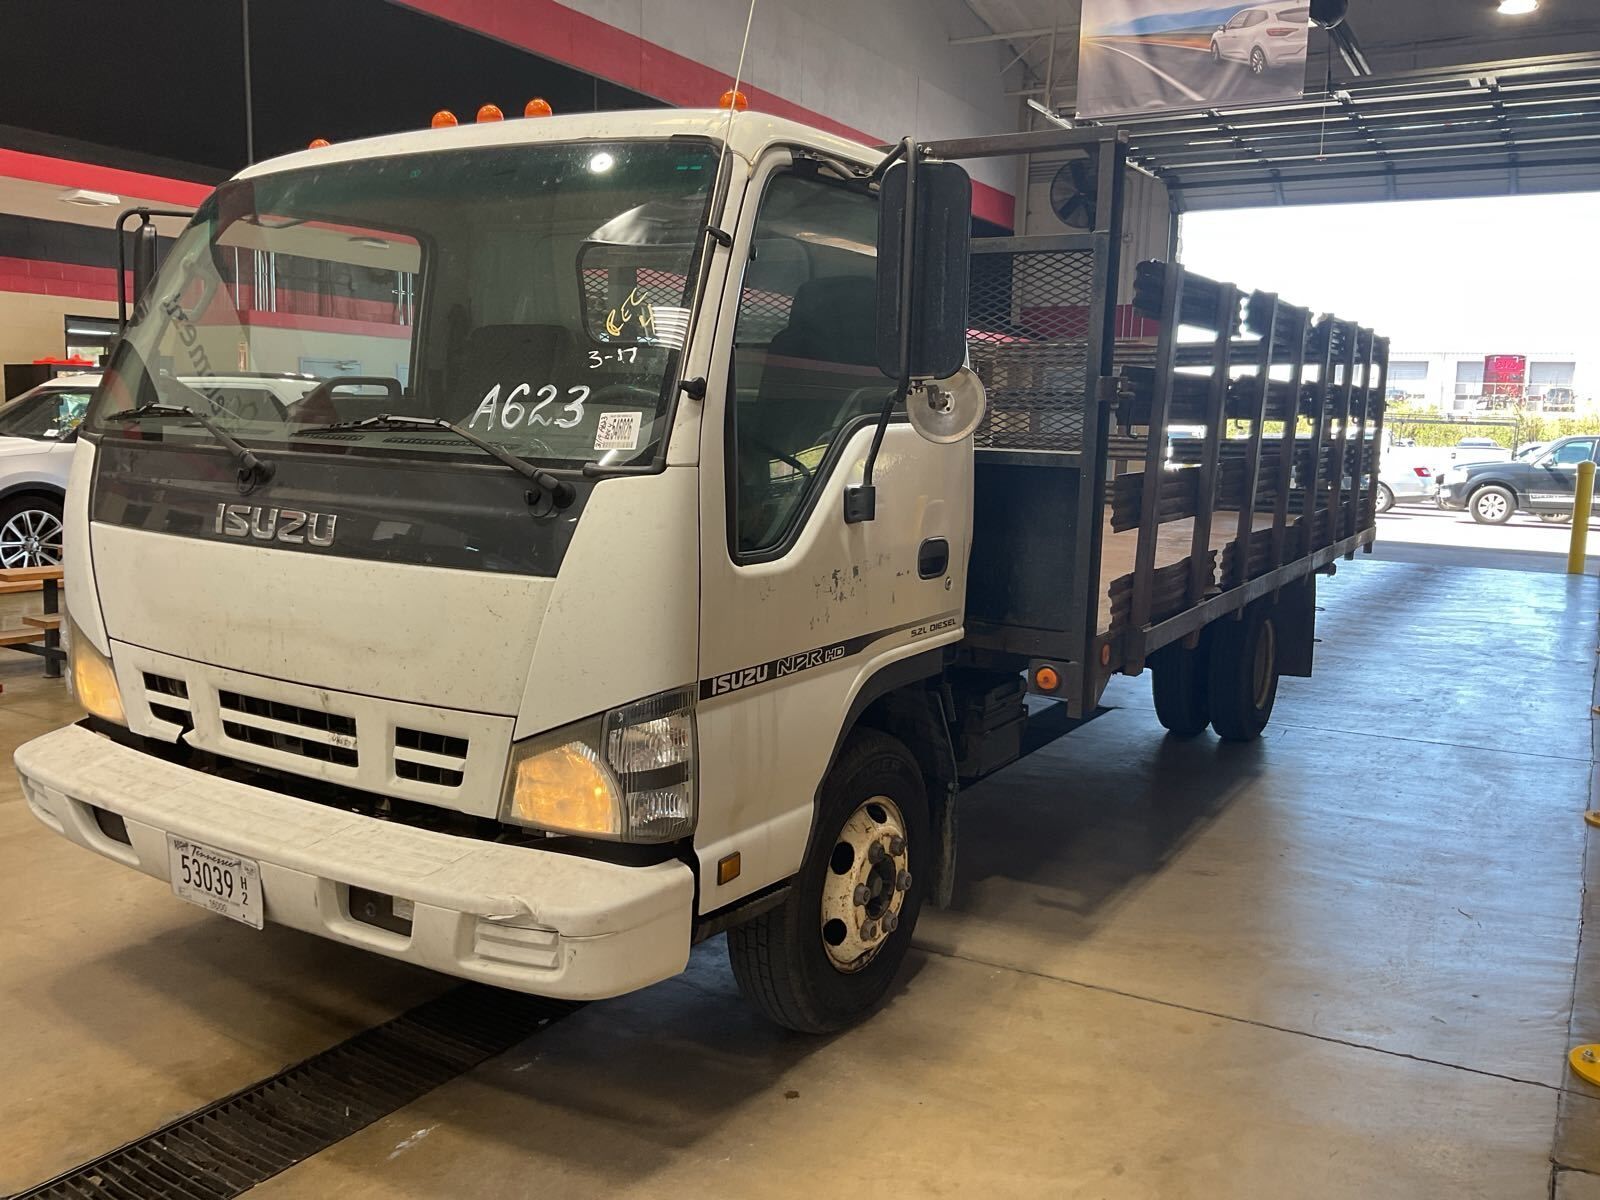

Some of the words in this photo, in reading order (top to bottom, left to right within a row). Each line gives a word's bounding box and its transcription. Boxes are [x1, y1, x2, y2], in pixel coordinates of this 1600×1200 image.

[468, 383, 590, 431] A623
[215, 502, 338, 547] ISUZU
[929, 618, 956, 632] DIESEL
[711, 665, 768, 696] ISUZU
[776, 648, 823, 677] NPR
[825, 646, 845, 662] HD
[181, 854, 234, 899] 53039
[191, 844, 240, 868] Tennessee
